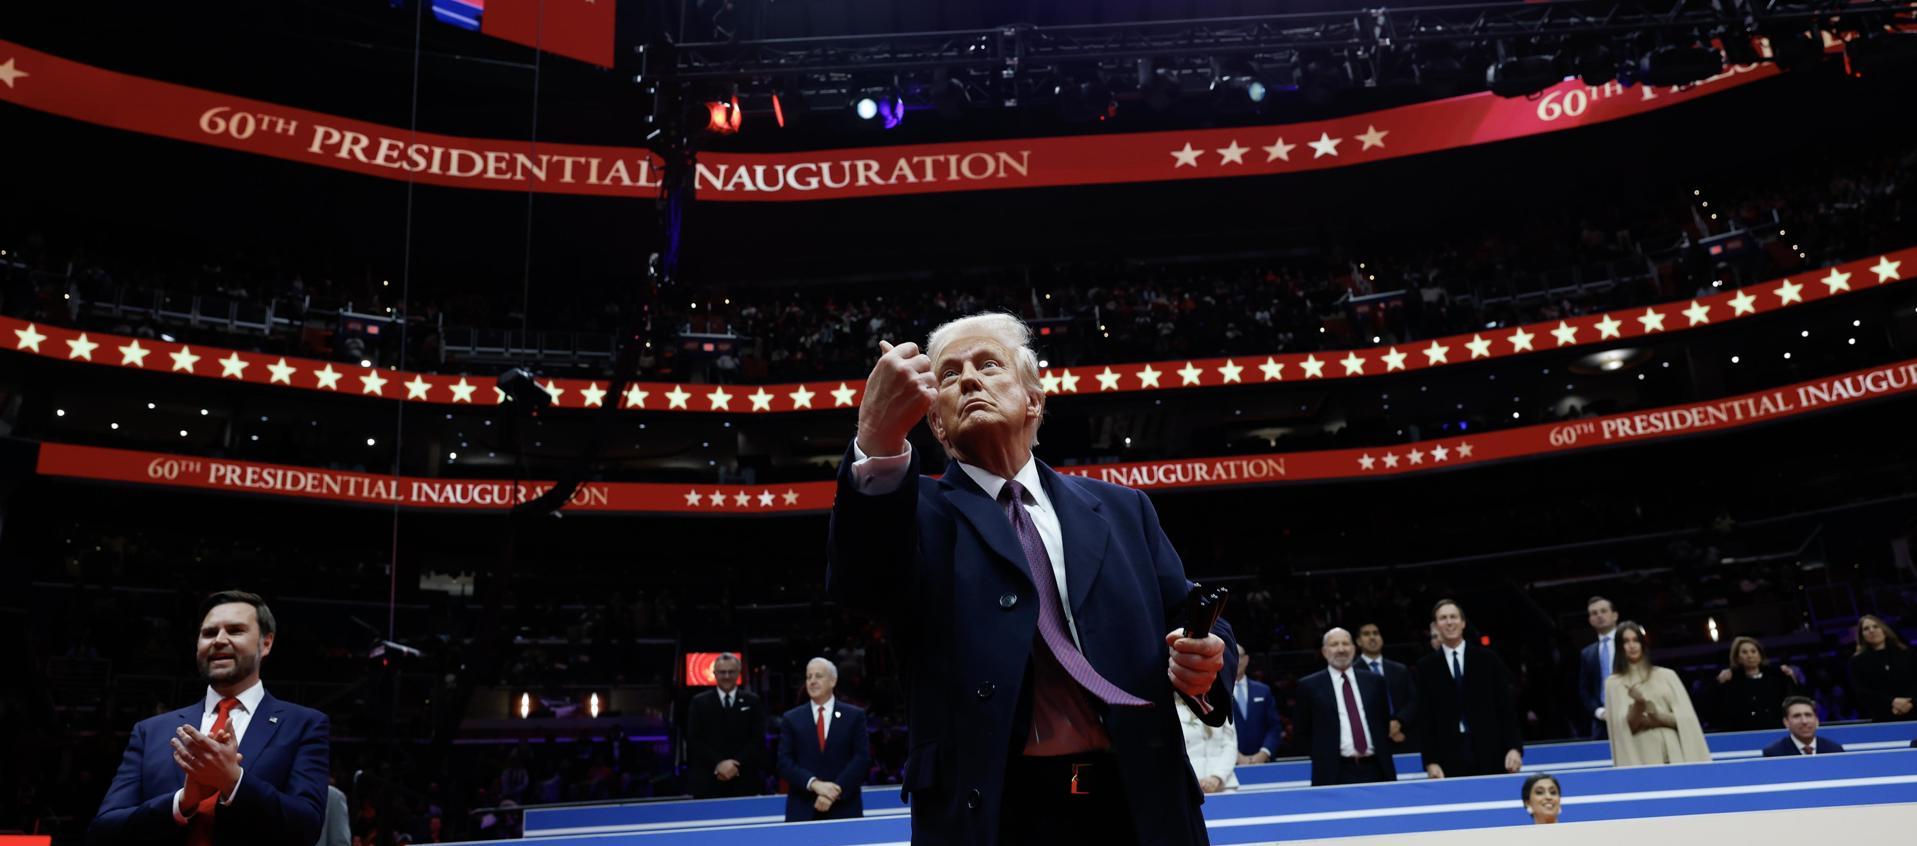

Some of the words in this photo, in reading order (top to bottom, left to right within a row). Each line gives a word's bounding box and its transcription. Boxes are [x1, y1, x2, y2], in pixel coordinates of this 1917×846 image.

[199, 107, 297, 139] 60TH
[308, 125, 662, 188] PRESIDENTIAL
[694, 151, 1031, 192] NAUGURATION
[1550, 423, 1595, 446] 60TH
[1601, 392, 1794, 439] PRESIDENTIAL
[148, 457, 201, 480] 60TH
[208, 464, 403, 501] PRESIDENTIAL
[1101, 458, 1285, 486] INAUGURATION
